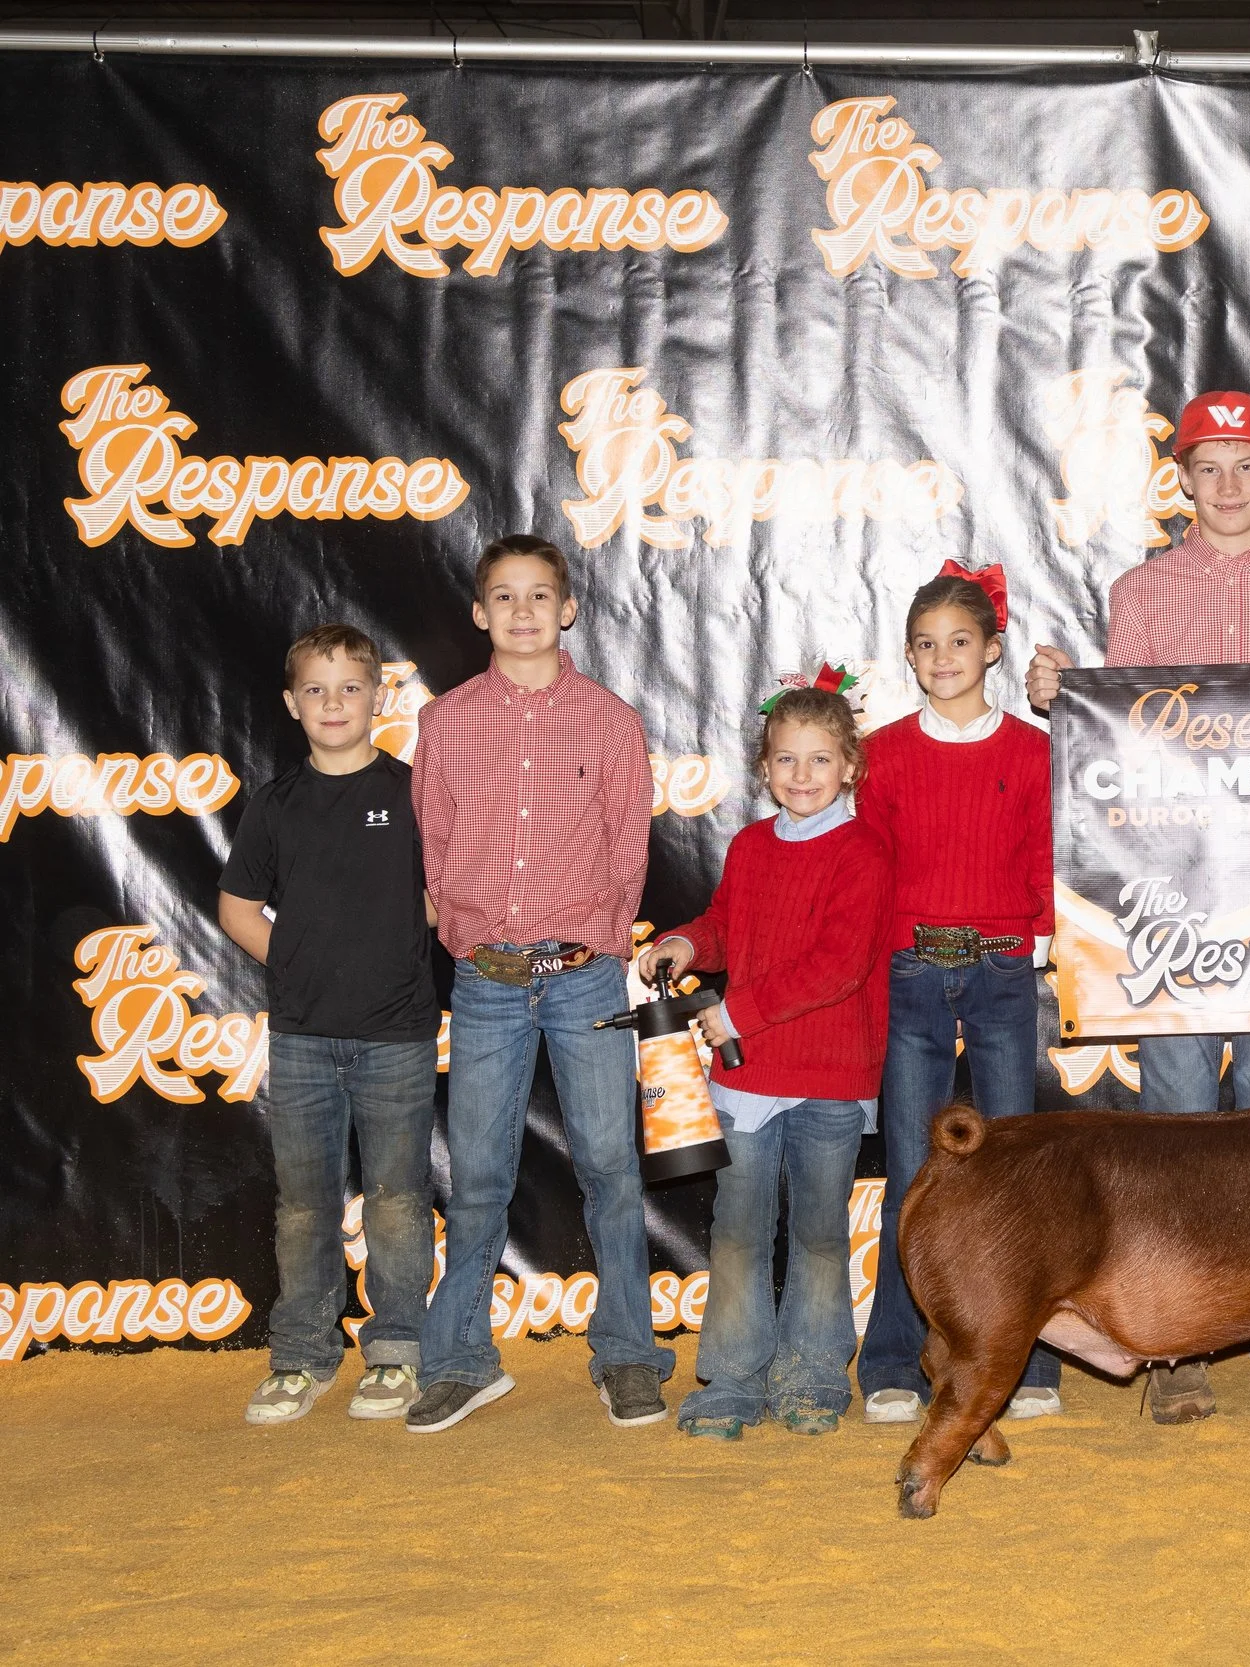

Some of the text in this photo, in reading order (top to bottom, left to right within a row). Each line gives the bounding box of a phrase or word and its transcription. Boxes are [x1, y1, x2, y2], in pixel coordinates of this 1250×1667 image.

[322, 97, 418, 171] The
[815, 99, 907, 173] The
[0, 187, 221, 240] ponse
[327, 147, 721, 270] Response
[818, 149, 1202, 271] Response
[66, 367, 163, 442] The
[565, 370, 659, 444] The
[71, 417, 463, 541] Response
[568, 420, 960, 543] Response
[0, 758, 233, 836] ponse
[1107, 804, 1212, 829] DUROC
[1117, 876, 1188, 933] The
[79, 928, 174, 1000] The
[532, 958, 563, 974] 580
[0, 1284, 246, 1360] ponse
